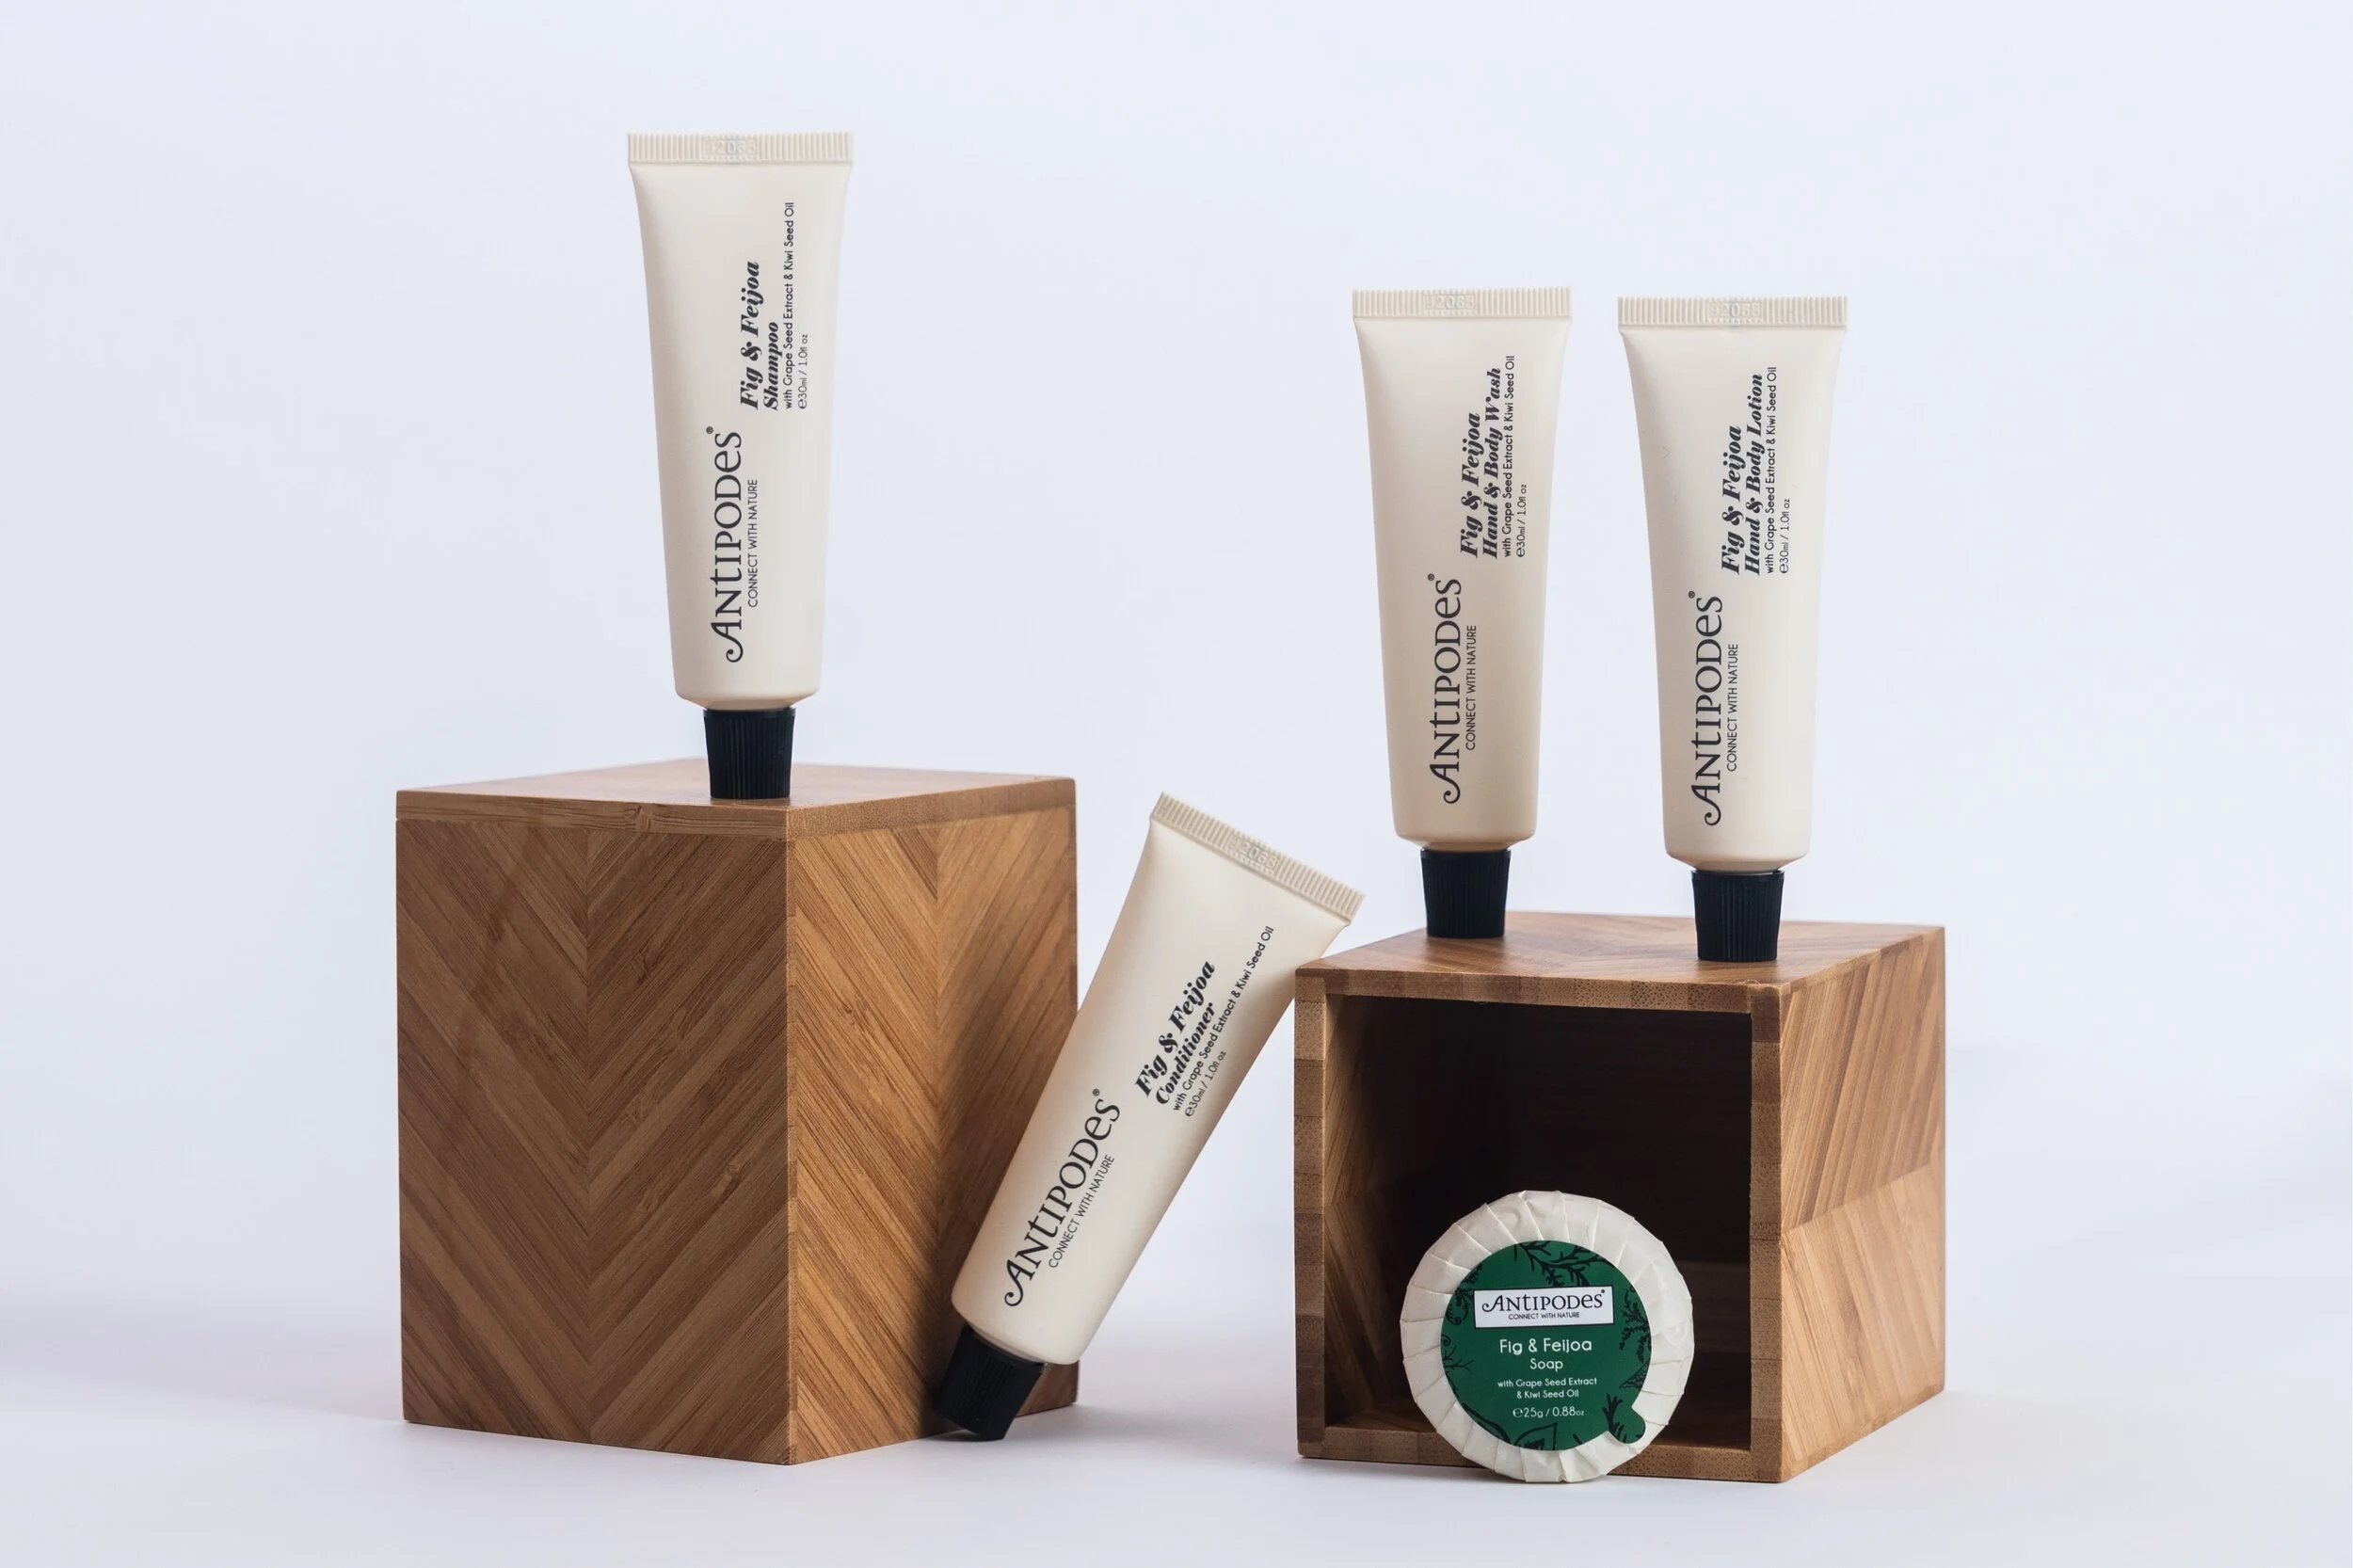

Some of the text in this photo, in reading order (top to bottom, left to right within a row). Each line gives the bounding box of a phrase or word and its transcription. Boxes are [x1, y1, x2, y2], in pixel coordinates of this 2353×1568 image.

[784, 202, 793, 216] Oil
[784, 220, 793, 247] Seed
[784, 251, 792, 270] Kiwi
[783, 283, 792, 319] Extract
[741, 262, 763, 410] Fig & Feijoa
[783, 323, 792, 349] Seed
[763, 322, 782, 410] Shampoo
[783, 353, 794, 386] Grape
[1505, 356, 1514, 370] Oil
[1767, 367, 1776, 381] Oil
[783, 390, 792, 408] with
[1504, 374, 1513, 399] Seed
[1767, 385, 1776, 411] Seed
[1504, 403, 1513, 422] Kiwi
[1766, 415, 1775, 435] Kiwi
[1482, 368, 1503, 559] Hand & Body Wash
[1501, 434, 1513, 469] Extract
[1764, 448, 1775, 483] Extract
[1461, 413, 1484, 558] Fig & Feijoa
[1502, 472, 1512, 499] Seed
[1744, 375, 1765, 575] Hand & Body Lotion
[1721, 426, 1746, 574] Fig & Feijoa
[1765, 488, 1774, 514] Seed
[1502, 503, 1514, 535] Grape
[1765, 518, 1777, 551] Grape
[747, 480, 758, 607] CONNECT WITH NATURE
[1502, 538, 1511, 557] with
[1765, 554, 1773, 573] with
[1465, 626, 1476, 750] CONNECT WITH NATURE
[1727, 644, 1737, 772] CONNECT WITH NATURE
[1135, 962, 1214, 1096] Fig & Feijoa
[1174, 1094, 1187, 1110] with
[1182, 1061, 1203, 1090] Grape
[1199, 1032, 1218, 1059] Seed
[1212, 1000, 1236, 1032] Extract
[1235, 969, 1251, 989] Kiwi
[1246, 942, 1265, 968] Seed
[1261, 926, 1273, 941] Oil
[1157, 1002, 1214, 1104] Conditioner
[1048, 1155, 1114, 1268] CONNECT WITH NATURE
[1500, 1338, 1592, 1355] Fig & Feijoa
[1530, 1358, 1563, 1371] Soap
[1516, 1380, 1542, 1388] Grape
